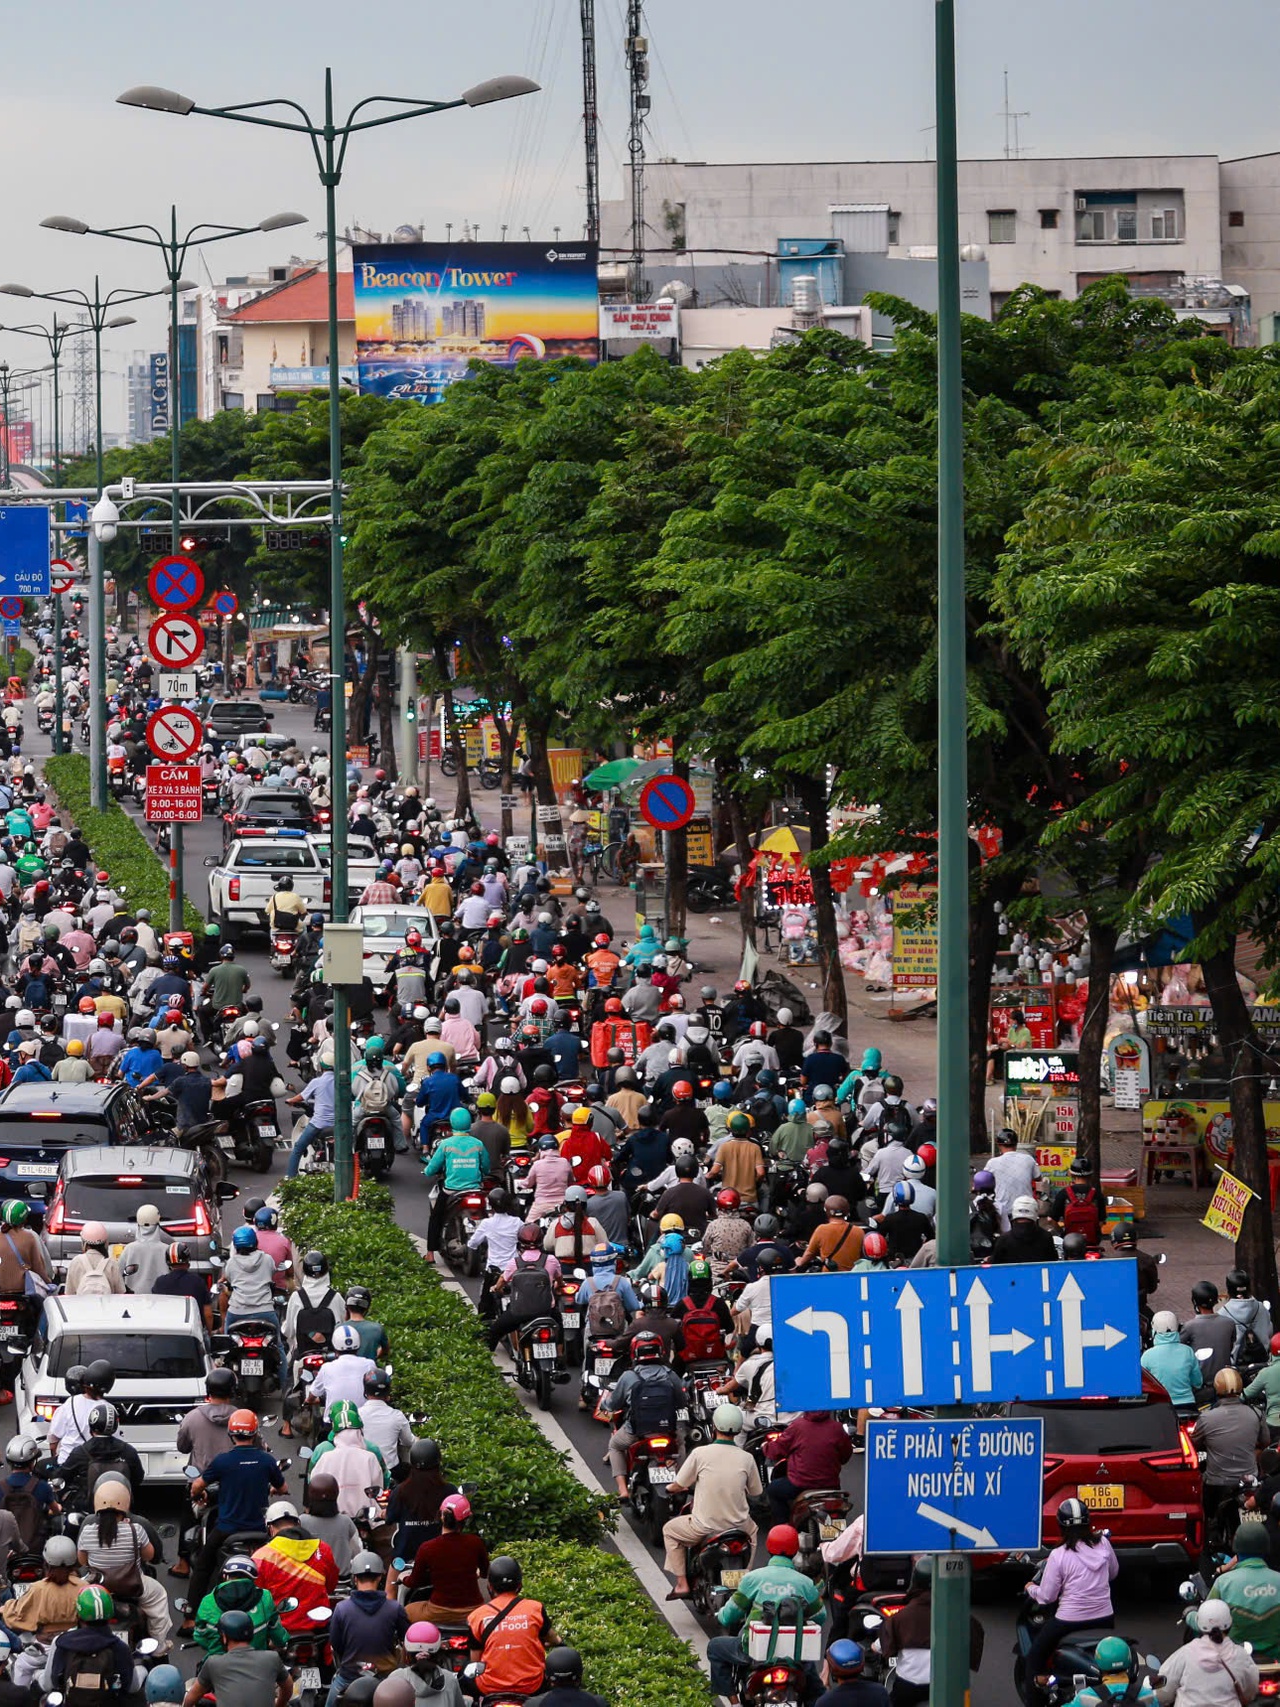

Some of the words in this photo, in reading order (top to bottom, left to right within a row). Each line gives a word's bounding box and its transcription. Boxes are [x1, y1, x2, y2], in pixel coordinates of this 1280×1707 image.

[362, 263, 440, 288] Beacon
[448, 268, 518, 287] Tower
[152, 356, 168, 429] Dr.Care
[19, 585, 31, 593] 700
[167, 680, 188, 692] 70m
[160, 767, 189, 780] CẤM
[148, 786, 158, 794] XE
[158, 786, 163, 794] 2
[164, 784, 174, 794] VÀ
[174, 786, 179, 794] 3
[180, 784, 200, 794] BÁNH
[151, 800, 197, 808] 9:00-16:00
[150, 810, 198, 819] 20:00-6:00
[709, 1015, 722, 1030] 10
[1056, 1106, 1074, 1117] 15k
[1056, 1121, 1074, 1132] 10k
[1221, 1219, 1238, 1236] 10K
[875, 1429, 897, 1459] RẼ
[904, 1426, 943, 1459] PHẢI
[951, 1424, 974, 1458] VỀ
[978, 1428, 1034, 1457] ĐƯỜNG
[908, 1461, 975, 1497] NGUYỄN
[985, 1466, 1002, 1496] XÍ
[1093, 1487, 1111, 1496] 18G
[1084, 1497, 1119, 1508] 001.00
[1244, 1584, 1277, 1598] Grab
[501, 1620, 528, 1630] Food
